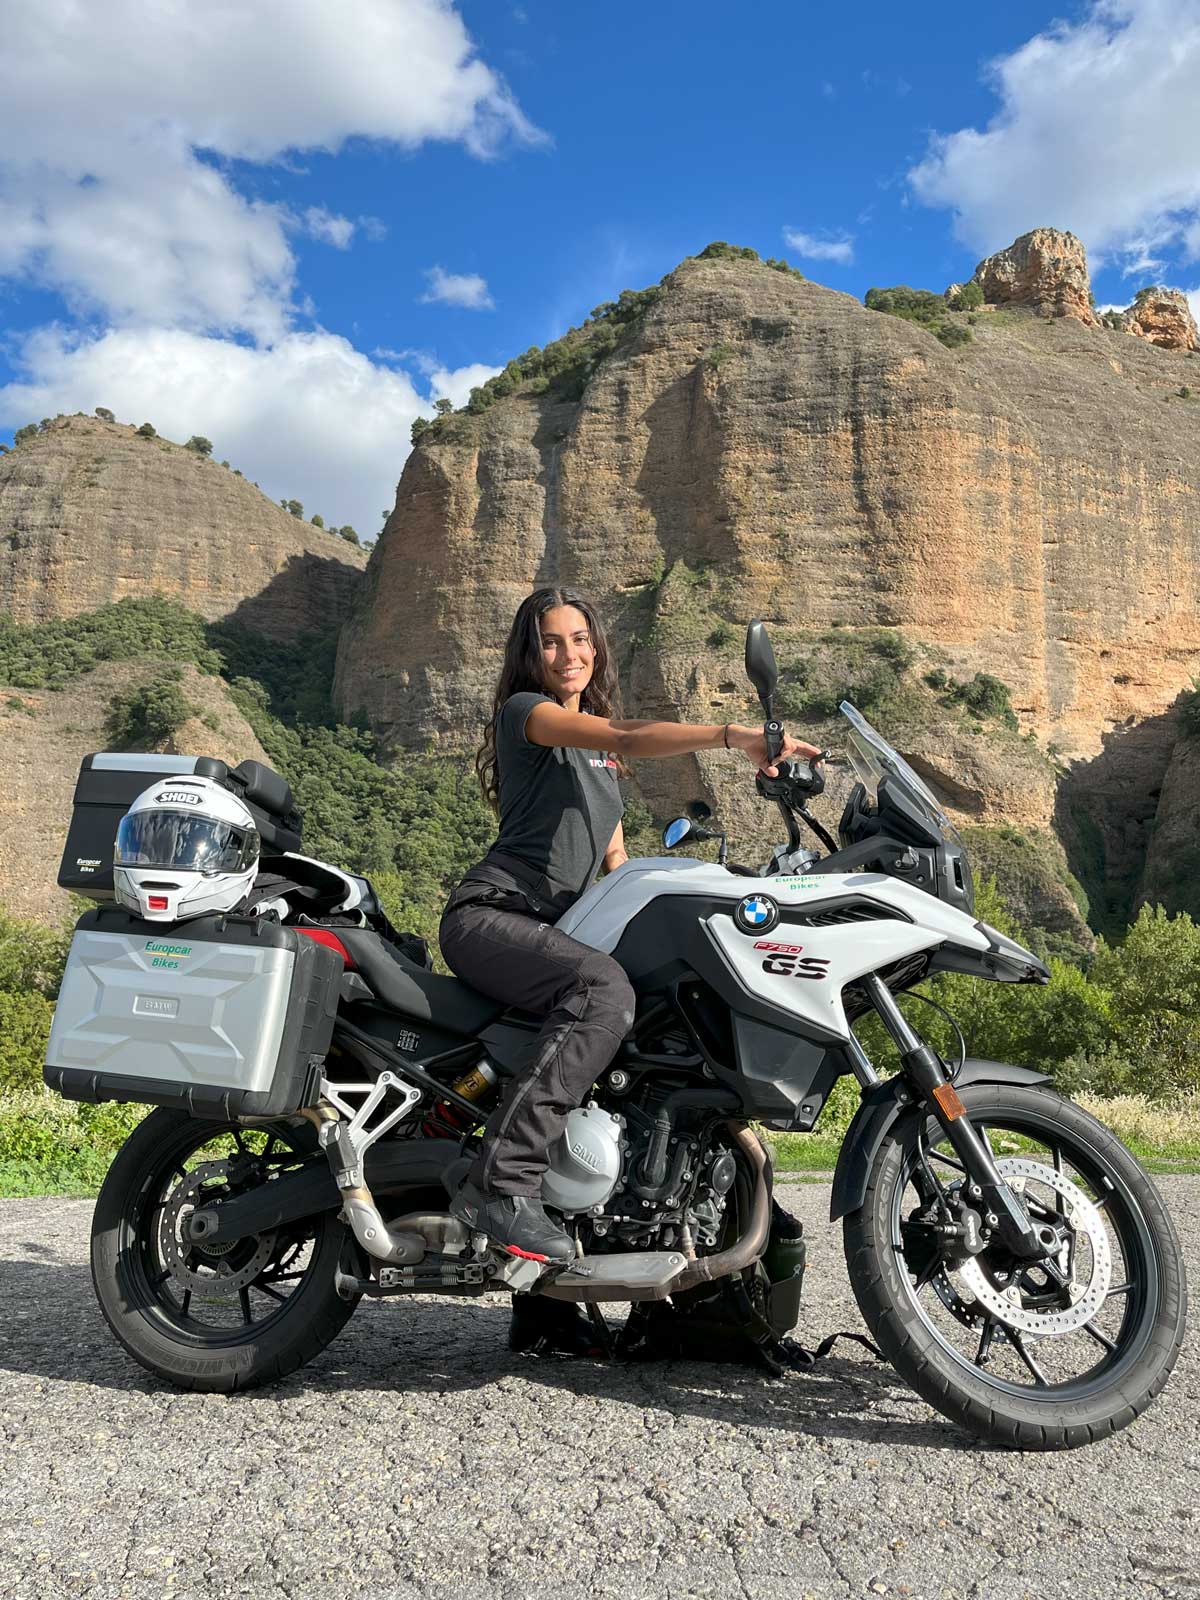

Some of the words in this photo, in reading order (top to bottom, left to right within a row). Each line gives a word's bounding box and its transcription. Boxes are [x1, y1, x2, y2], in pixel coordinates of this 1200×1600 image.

[159, 791, 200, 806] SHOEI
[775, 875, 825, 883] Europcar
[790, 882, 819, 891] Bikes
[743, 896, 773, 909] BMW
[145, 941, 192, 956] Europcar
[152, 957, 179, 969] Bikes
[762, 953, 831, 980] GS
[571, 1142, 600, 1169] BMW
